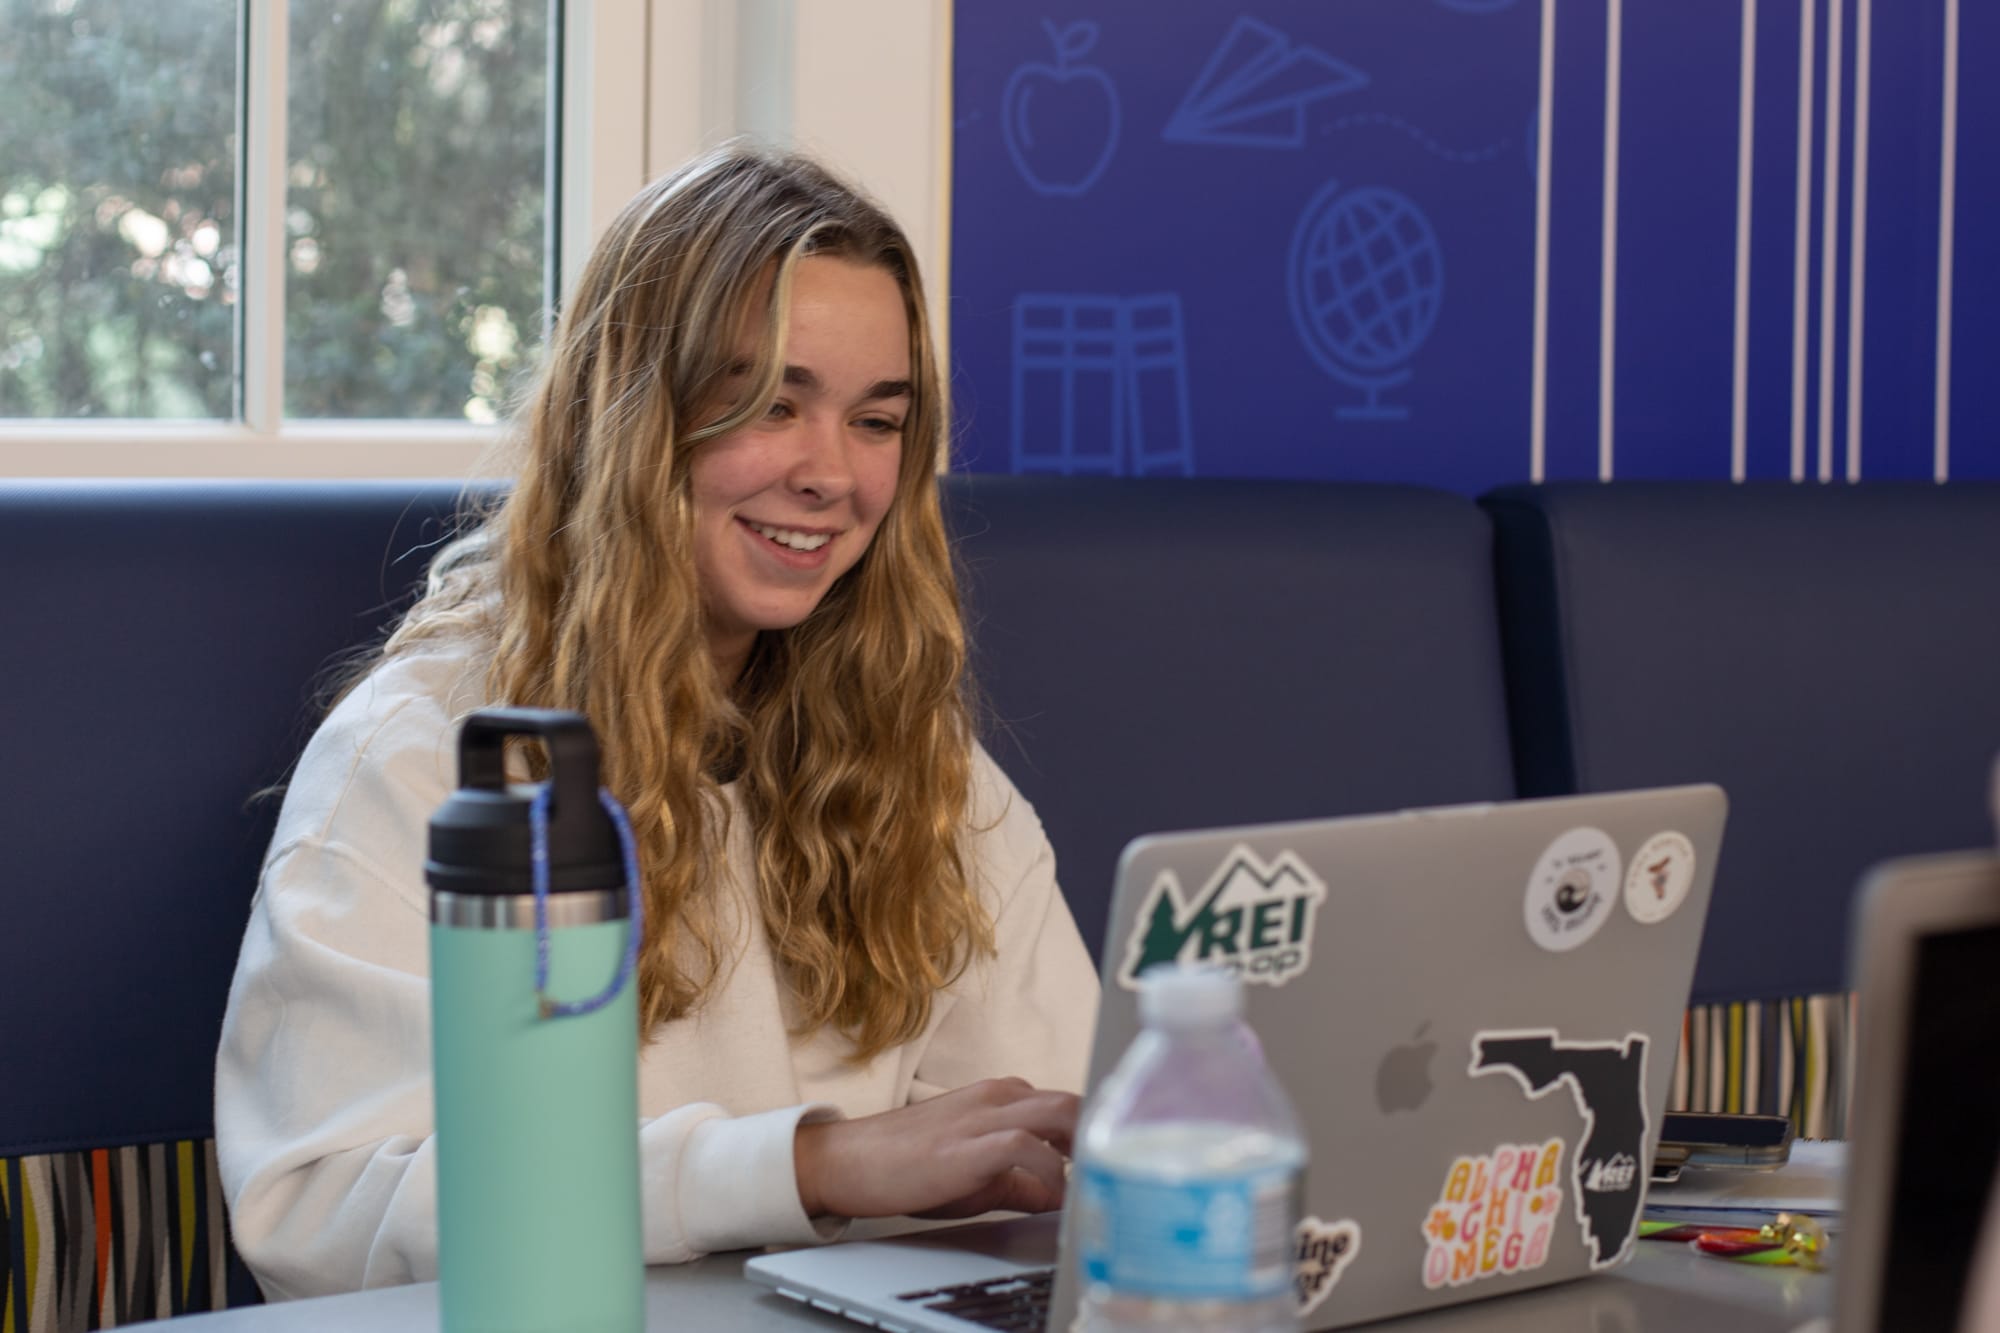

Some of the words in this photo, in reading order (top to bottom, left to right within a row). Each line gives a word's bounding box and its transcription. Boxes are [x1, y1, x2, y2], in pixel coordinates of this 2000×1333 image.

[1197, 895, 1308, 959] REI
[1446, 1143, 1561, 1204] ALPHA
[1460, 1188, 1525, 1243] CHI
[1426, 1222, 1550, 1285] OMEGA
